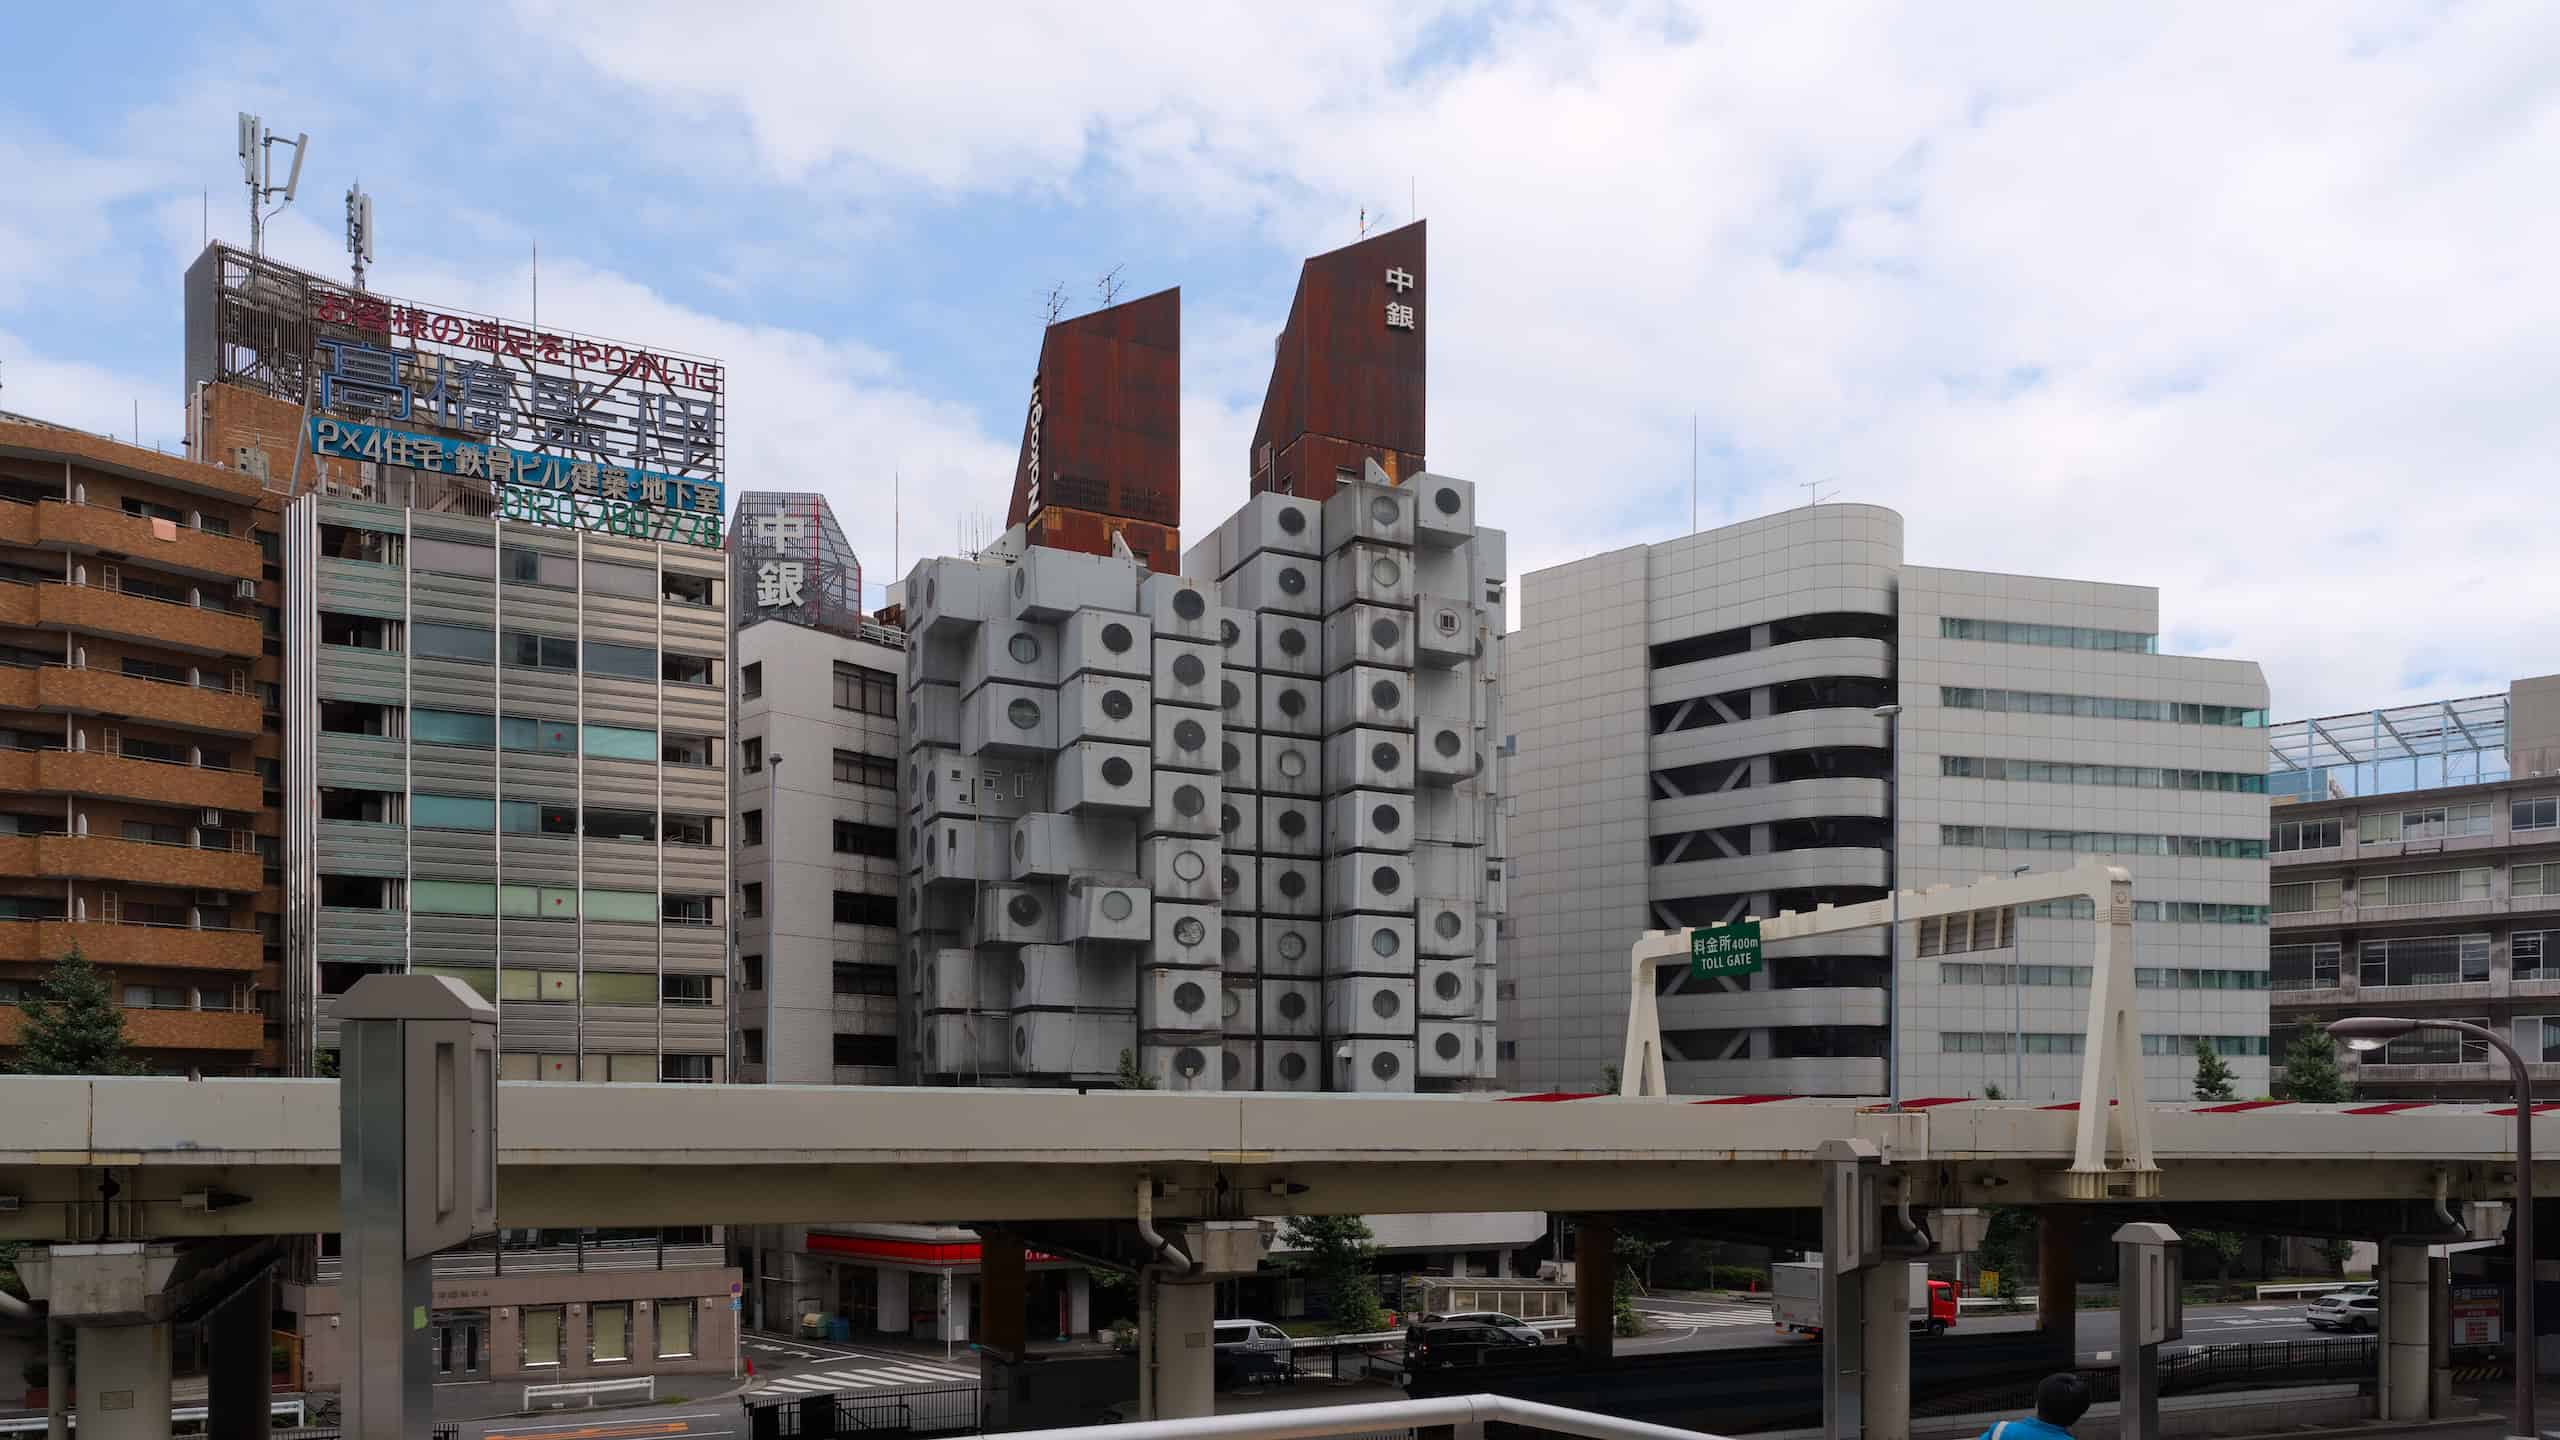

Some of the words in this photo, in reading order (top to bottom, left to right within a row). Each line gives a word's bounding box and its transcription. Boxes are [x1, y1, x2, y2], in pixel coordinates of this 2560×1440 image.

[1385, 266, 1415, 330] 中銀
[319, 293, 718, 391] お客様の満足をやりがいに
[503, 485, 720, 548] 0120-789-778
[757, 507, 805, 608] 中銀
[1701, 957, 1725, 970] TOLL
[1726, 952, 1752, 967] GATE
